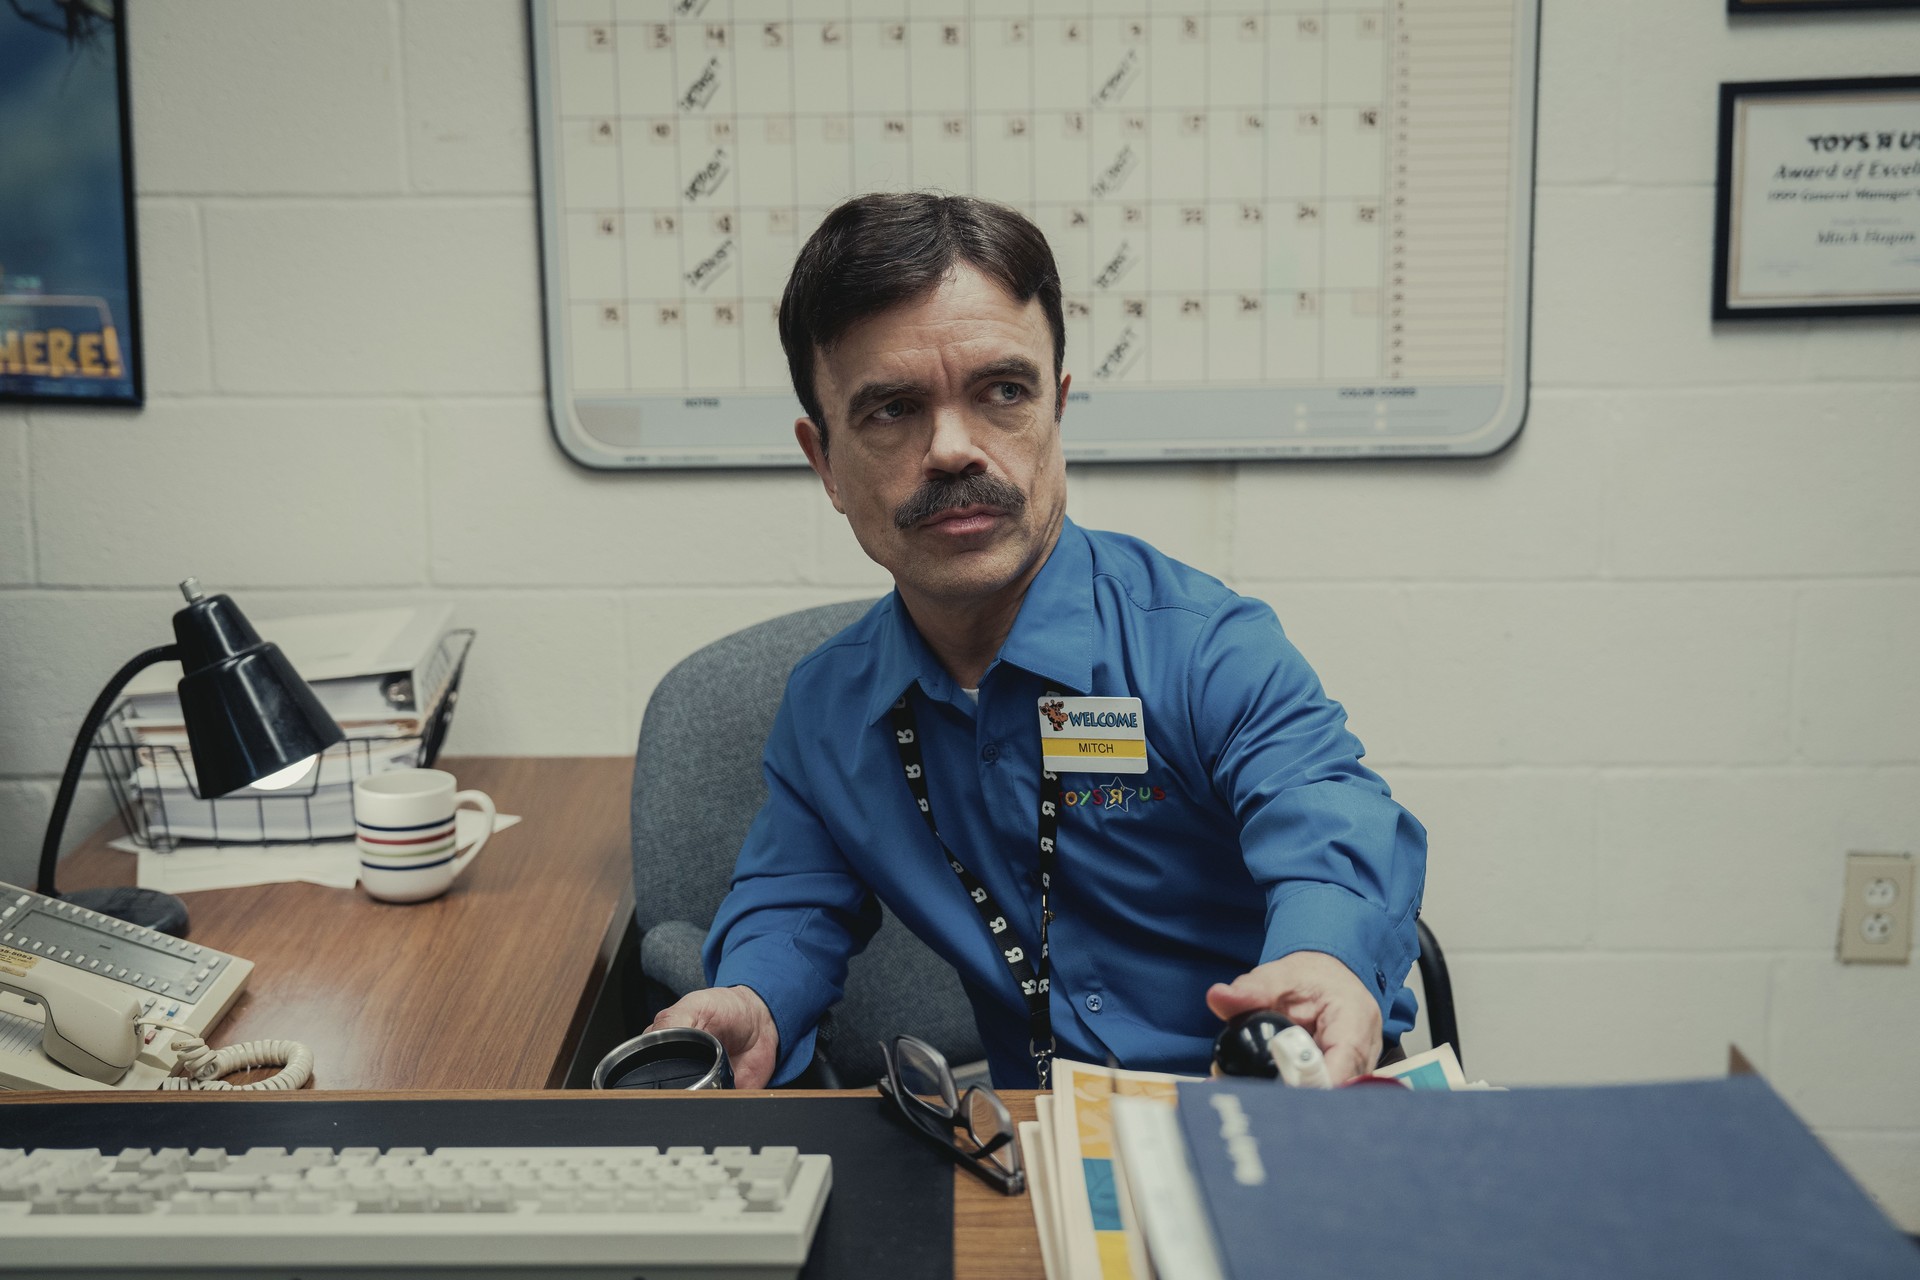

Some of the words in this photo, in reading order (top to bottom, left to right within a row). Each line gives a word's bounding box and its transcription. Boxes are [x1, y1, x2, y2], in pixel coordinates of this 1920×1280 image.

[764, 23, 782, 46] 5
[1807, 132, 1870, 151] TOYS
[1774, 161, 1838, 179] Award
[1843, 160, 1864, 182] of
[1802, 187, 1849, 200] General
[1069, 711, 1138, 728] WELCOME
[1078, 743, 1114, 754] MITCH
[1139, 786, 1166, 801] US
